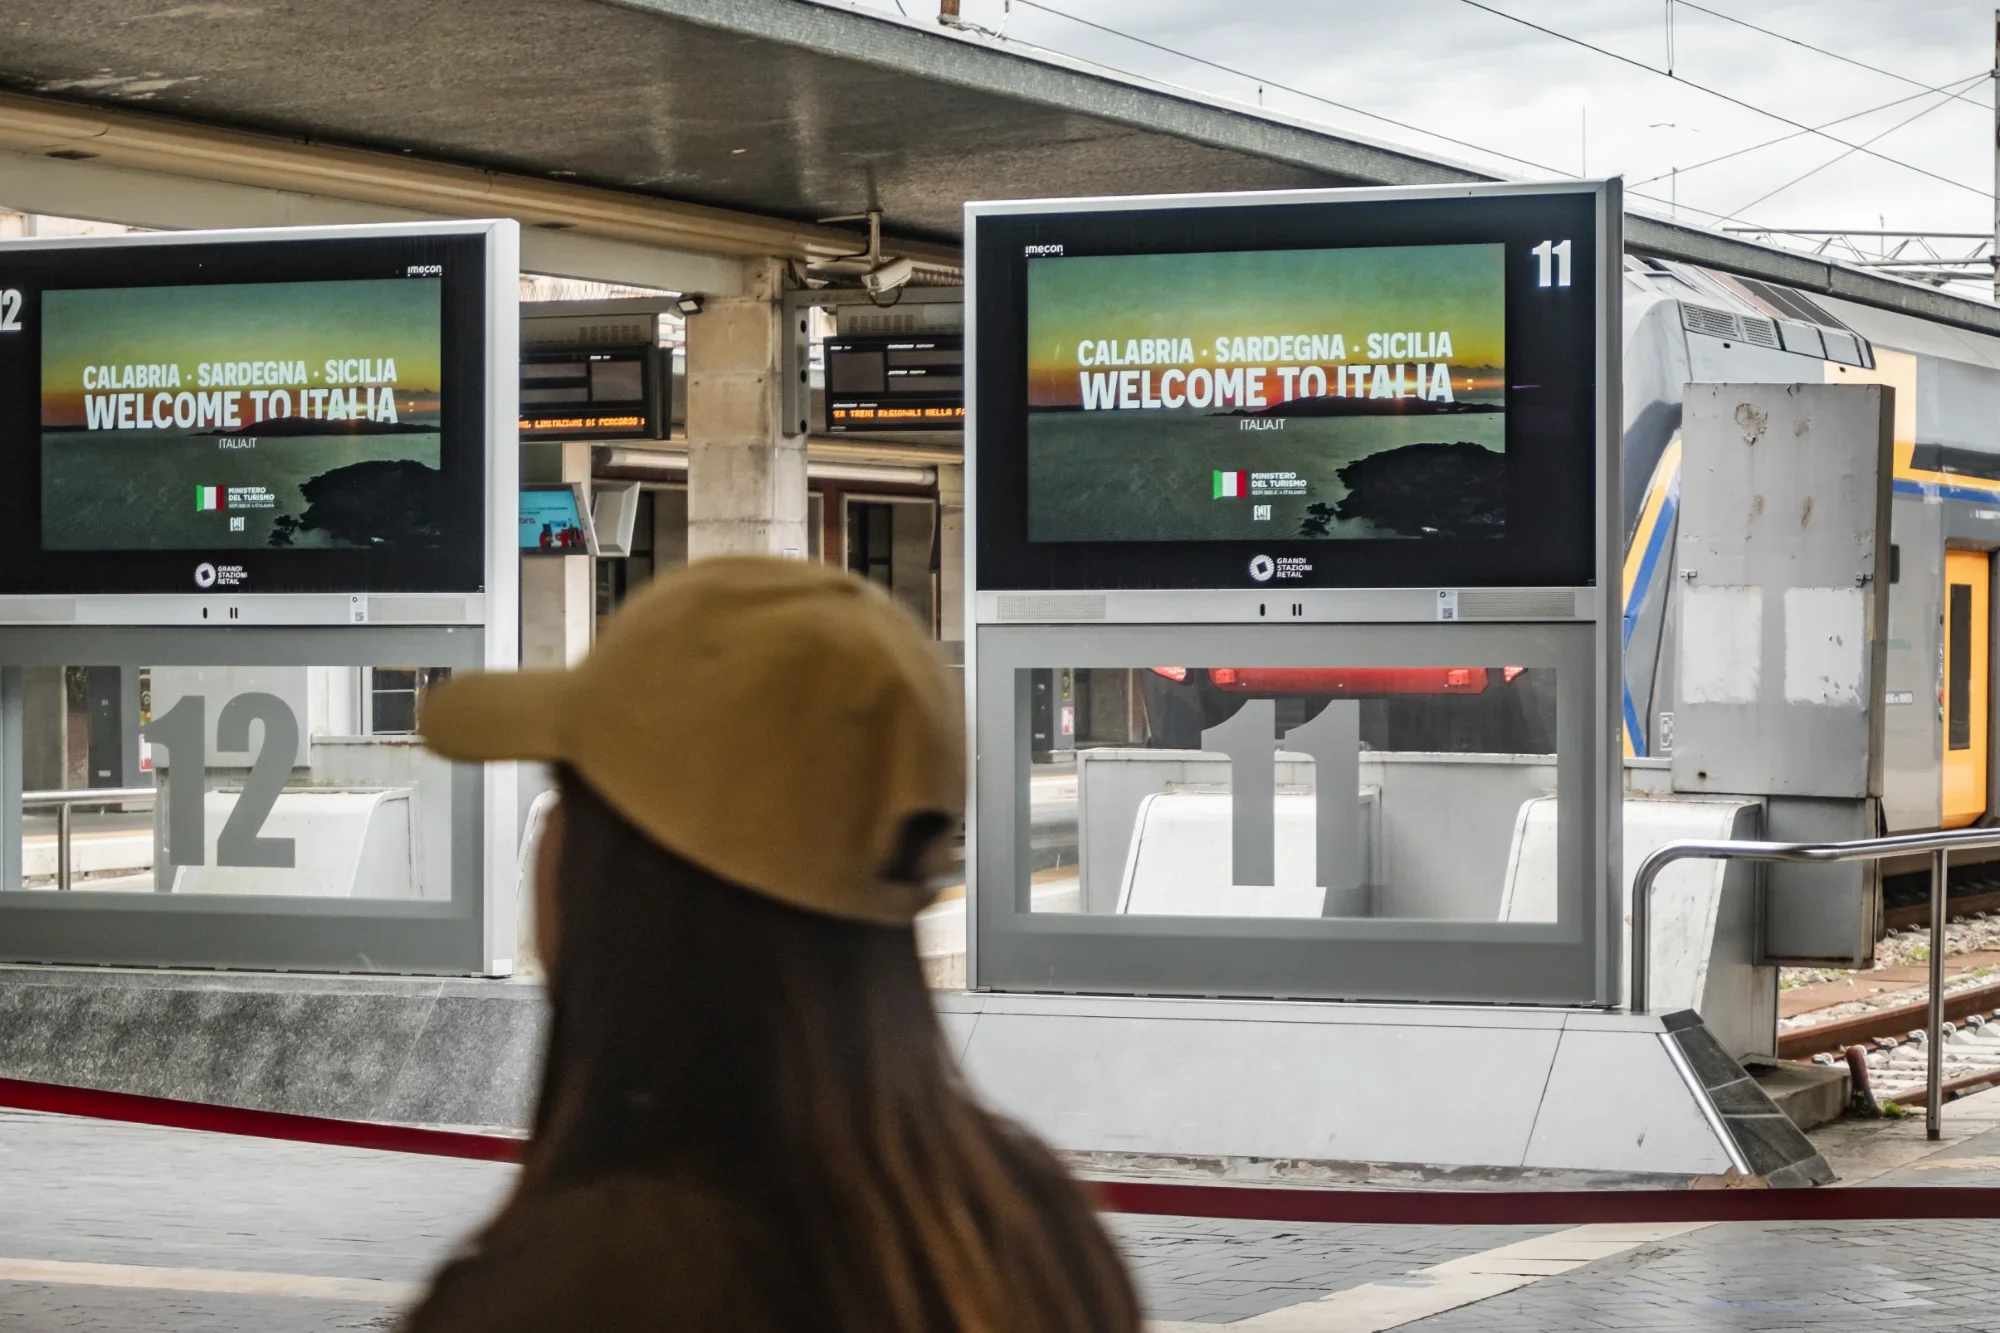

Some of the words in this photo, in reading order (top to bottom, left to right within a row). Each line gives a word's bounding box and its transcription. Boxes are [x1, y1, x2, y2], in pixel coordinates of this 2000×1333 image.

[1025, 244, 1064, 256] imecon
[1531, 239, 1572, 287] 11
[407, 264, 442, 276] imecon
[0, 288, 22, 331] 2
[1077, 338, 1195, 367] CALABRIA
[1215, 334, 1346, 363] SARDEGNA
[1367, 331, 1454, 360] SICILIA
[82, 364, 181, 390] CALABRIA
[197, 360, 308, 388] SARDEGNA
[324, 358, 398, 385] SICILIA
[1080, 366, 1267, 410] WELCOME
[1277, 364, 1327, 401] TO
[1337, 363, 1455, 403] ITALIA
[84, 391, 242, 430] WELCOME
[249, 389, 292, 424] TO
[300, 387, 399, 425] ITALIA
[849, 409, 874, 418] TRENI
[877, 408, 922, 417] REGIONALI
[598, 416, 638, 427] PERCORSO
[1240, 418, 1286, 430] ITALIA.IT
[218, 437, 258, 449] ITALIA.IT
[1251, 472, 1297, 480] MINISTERO
[228, 486, 267, 494] MINISTERO
[1251, 480, 1268, 488] DEL
[1269, 480, 1307, 488] TURISMO
[143, 691, 299, 868] 12
[1201, 698, 1360, 887] 11
